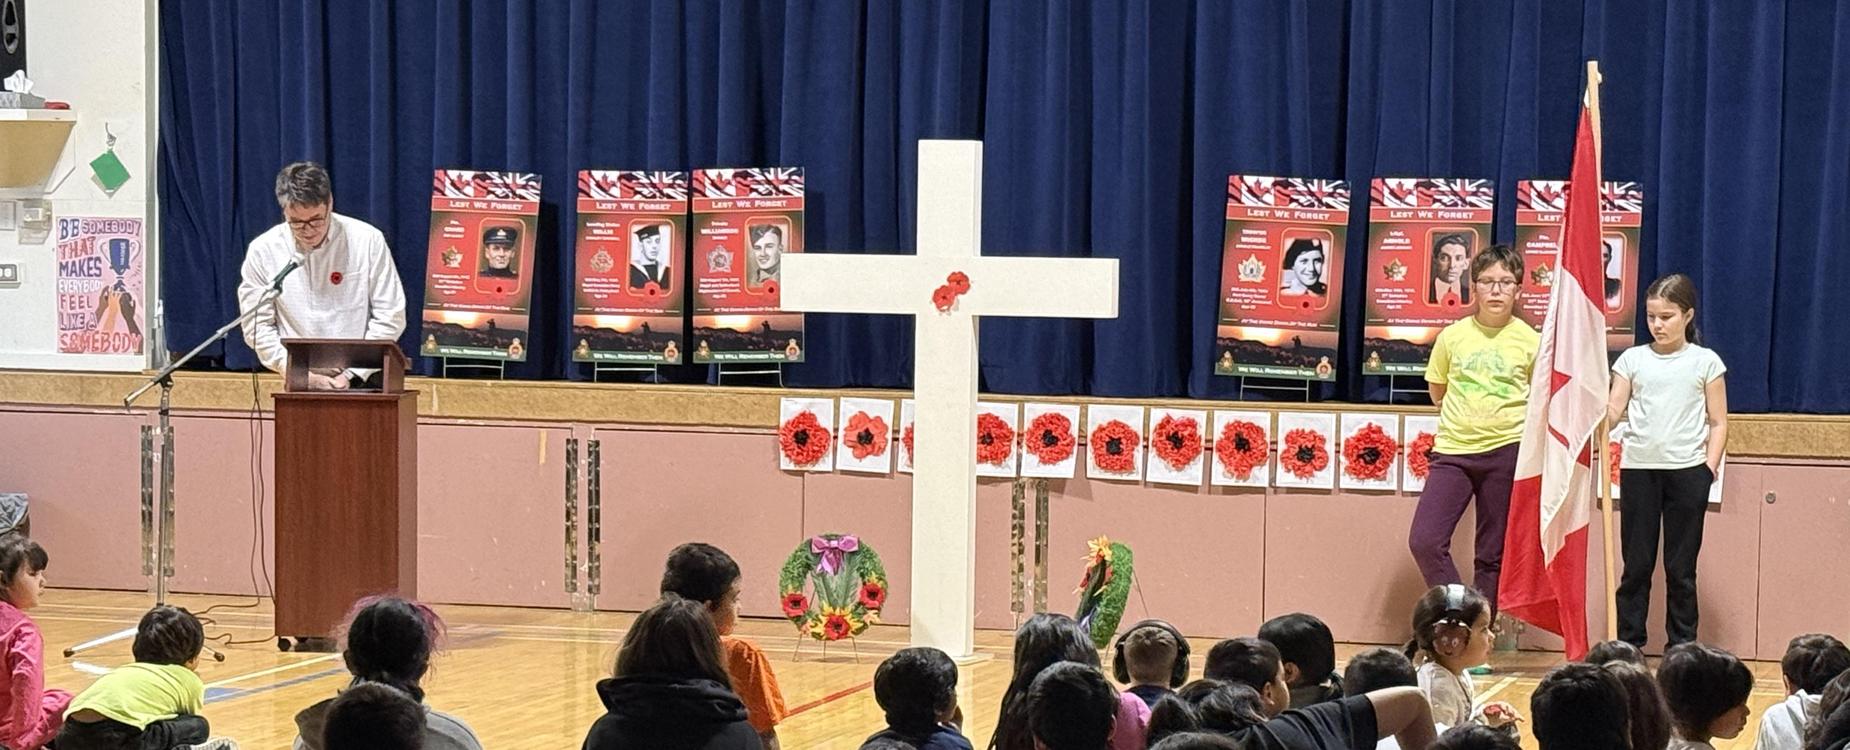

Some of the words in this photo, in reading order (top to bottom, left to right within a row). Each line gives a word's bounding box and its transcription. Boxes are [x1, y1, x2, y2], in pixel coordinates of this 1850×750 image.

[59, 218, 80, 240] BE
[82, 219, 142, 236] SOMEBODY
[58, 236, 96, 260] THAT
[58, 256, 102, 278] MAKES
[60, 294, 93, 310] FEEL
[59, 312, 86, 331] LIKE
[86, 312, 98, 332] A
[60, 332, 142, 353] SOMEBODY
